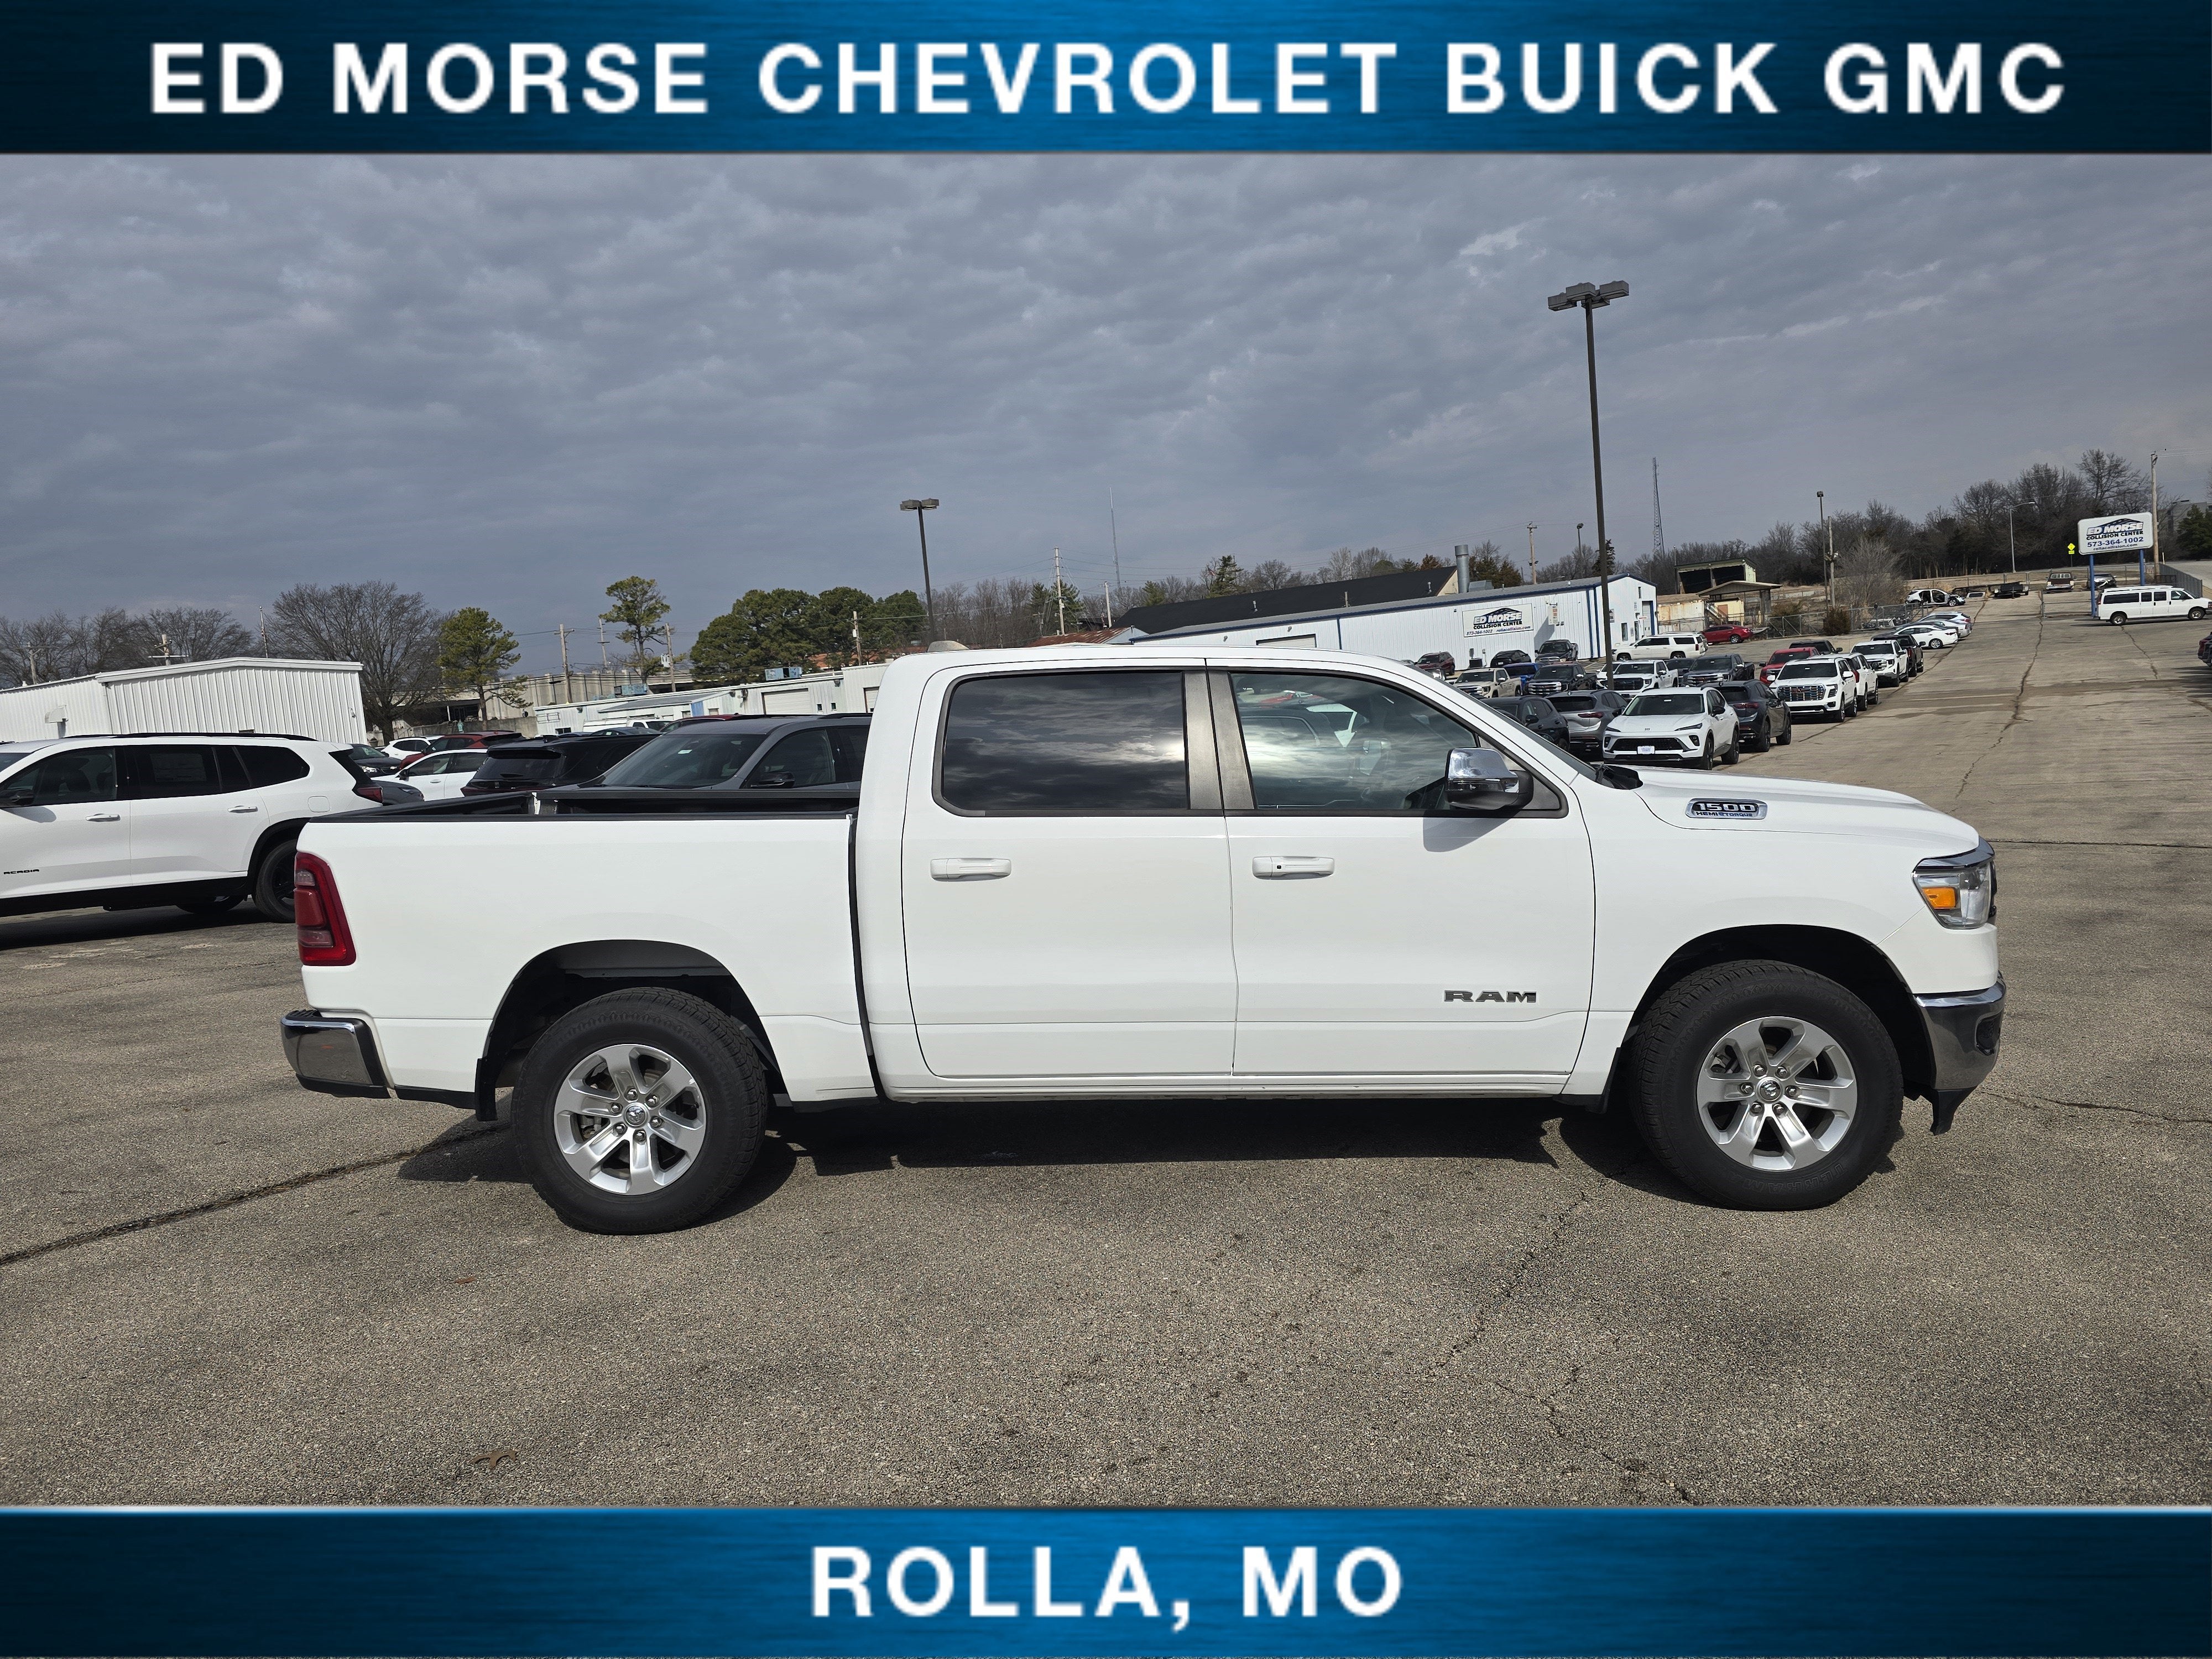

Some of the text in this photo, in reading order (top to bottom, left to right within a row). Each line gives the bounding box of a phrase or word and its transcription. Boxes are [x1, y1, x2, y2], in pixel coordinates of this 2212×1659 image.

[2087, 522, 2143, 535] ED MORSE
[2087, 536, 2144, 547] 573-364-1002
[1474, 612, 1522, 625] ED MORSE
[1695, 802, 1756, 812] 1500
[1444, 990, 1537, 1003] RAM
